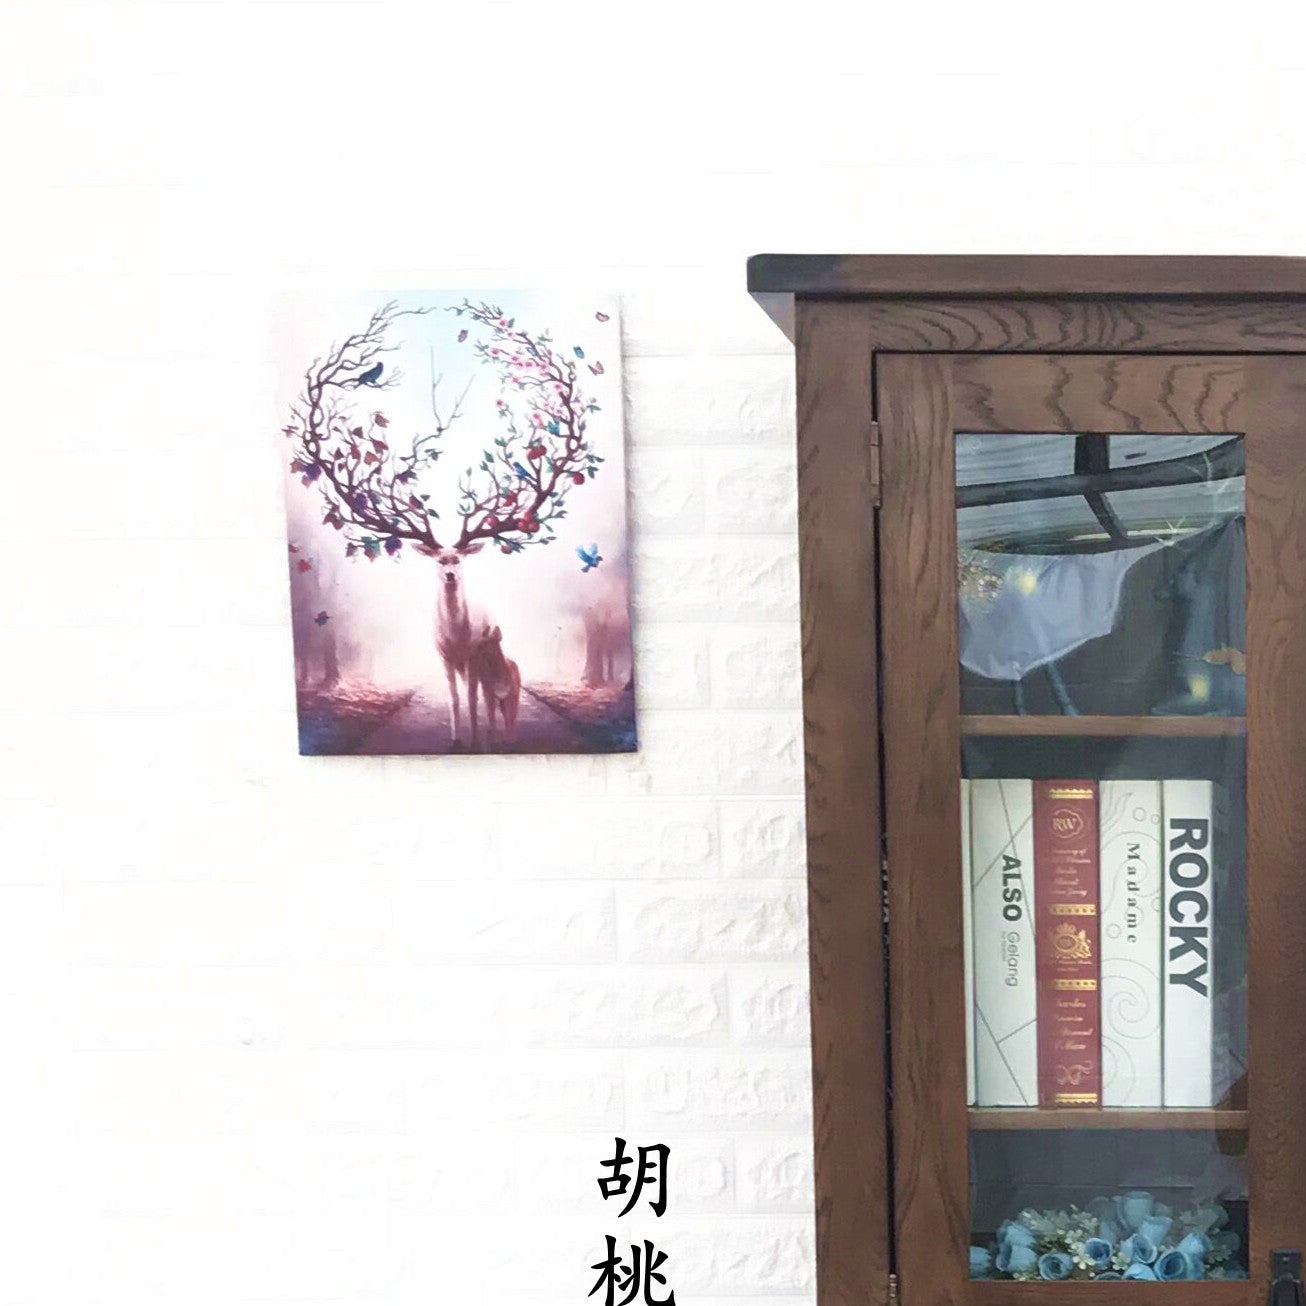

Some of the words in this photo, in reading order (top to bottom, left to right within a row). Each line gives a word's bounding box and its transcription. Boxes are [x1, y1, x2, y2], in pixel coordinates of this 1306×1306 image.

[1000, 853, 1024, 922] ALSO
[1126, 842, 1141, 944] Madame
[1168, 817, 1209, 998] ROCKY
[1005, 931, 1022, 988] Gelang
